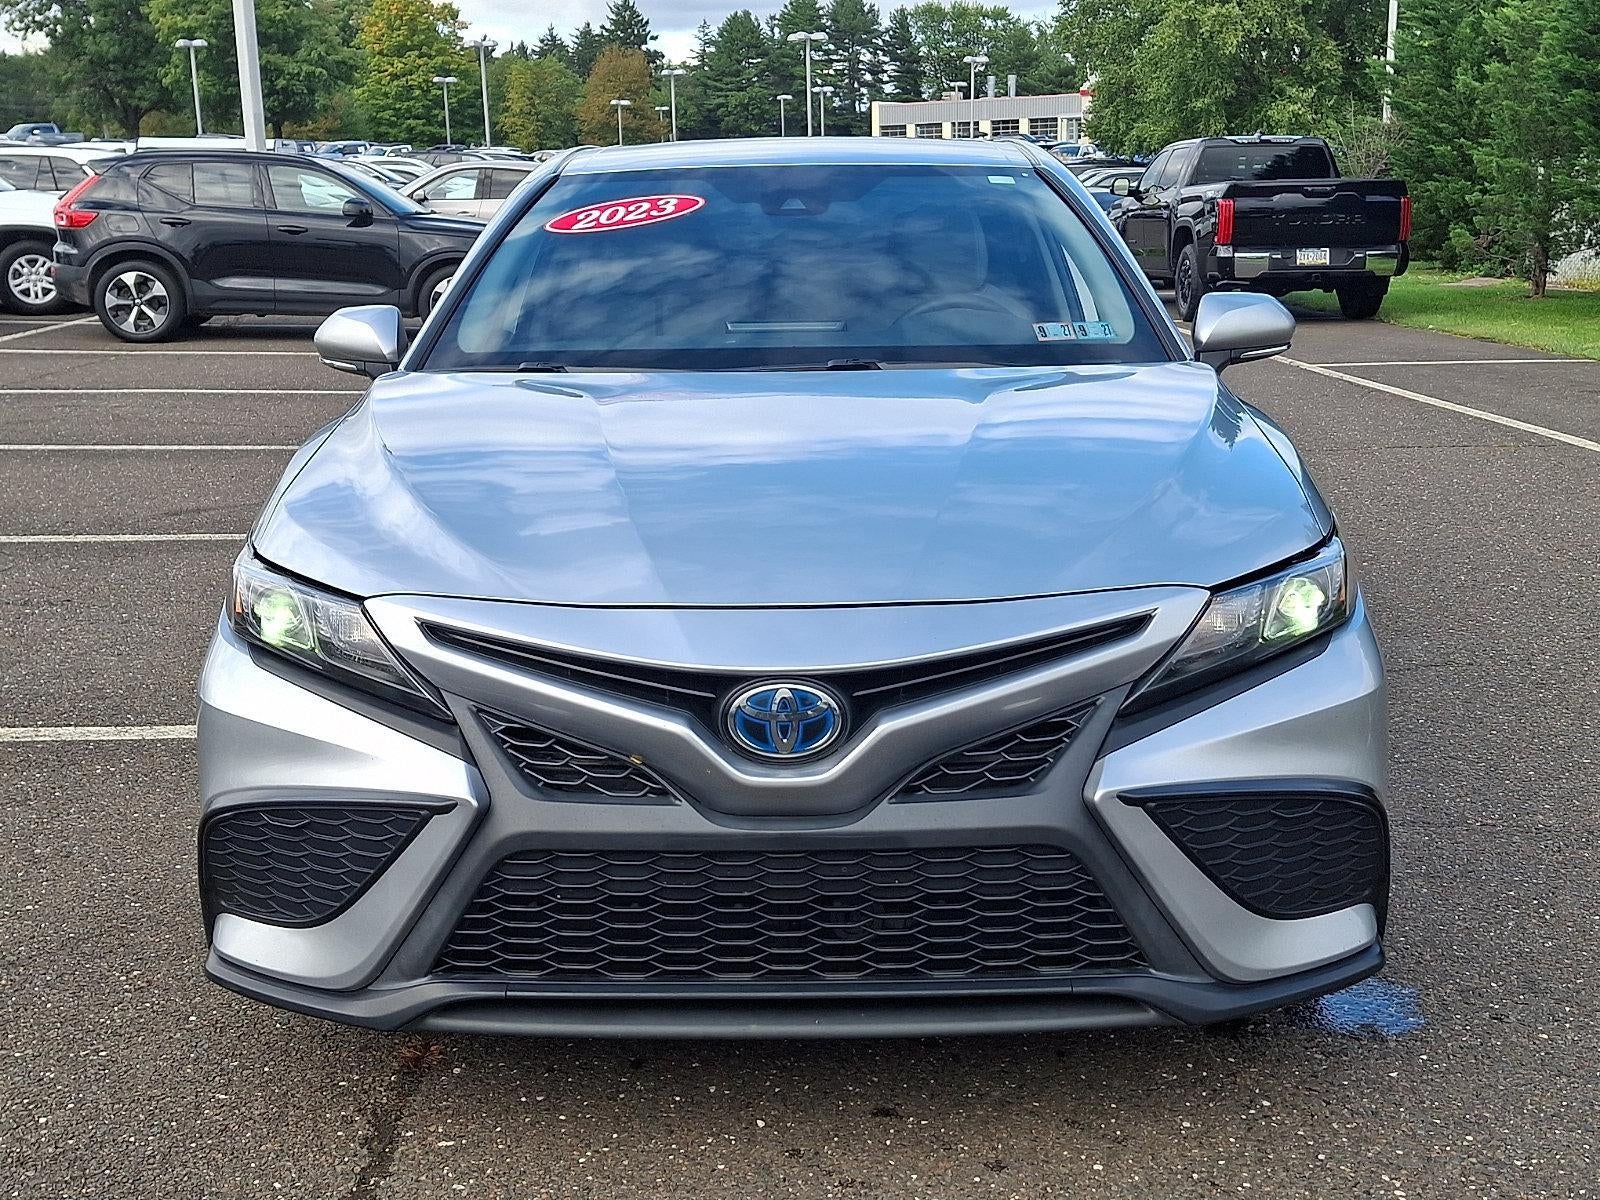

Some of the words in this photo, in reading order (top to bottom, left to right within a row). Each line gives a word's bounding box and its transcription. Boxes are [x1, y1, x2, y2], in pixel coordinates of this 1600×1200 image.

[570, 198, 680, 230] 2023
[1271, 212, 1366, 225] TUNDRA
[1037, 325, 1048, 338] 9
[1060, 324, 1072, 337] 27
[1078, 324, 1088, 337] 9
[1100, 323, 1112, 337] 27
